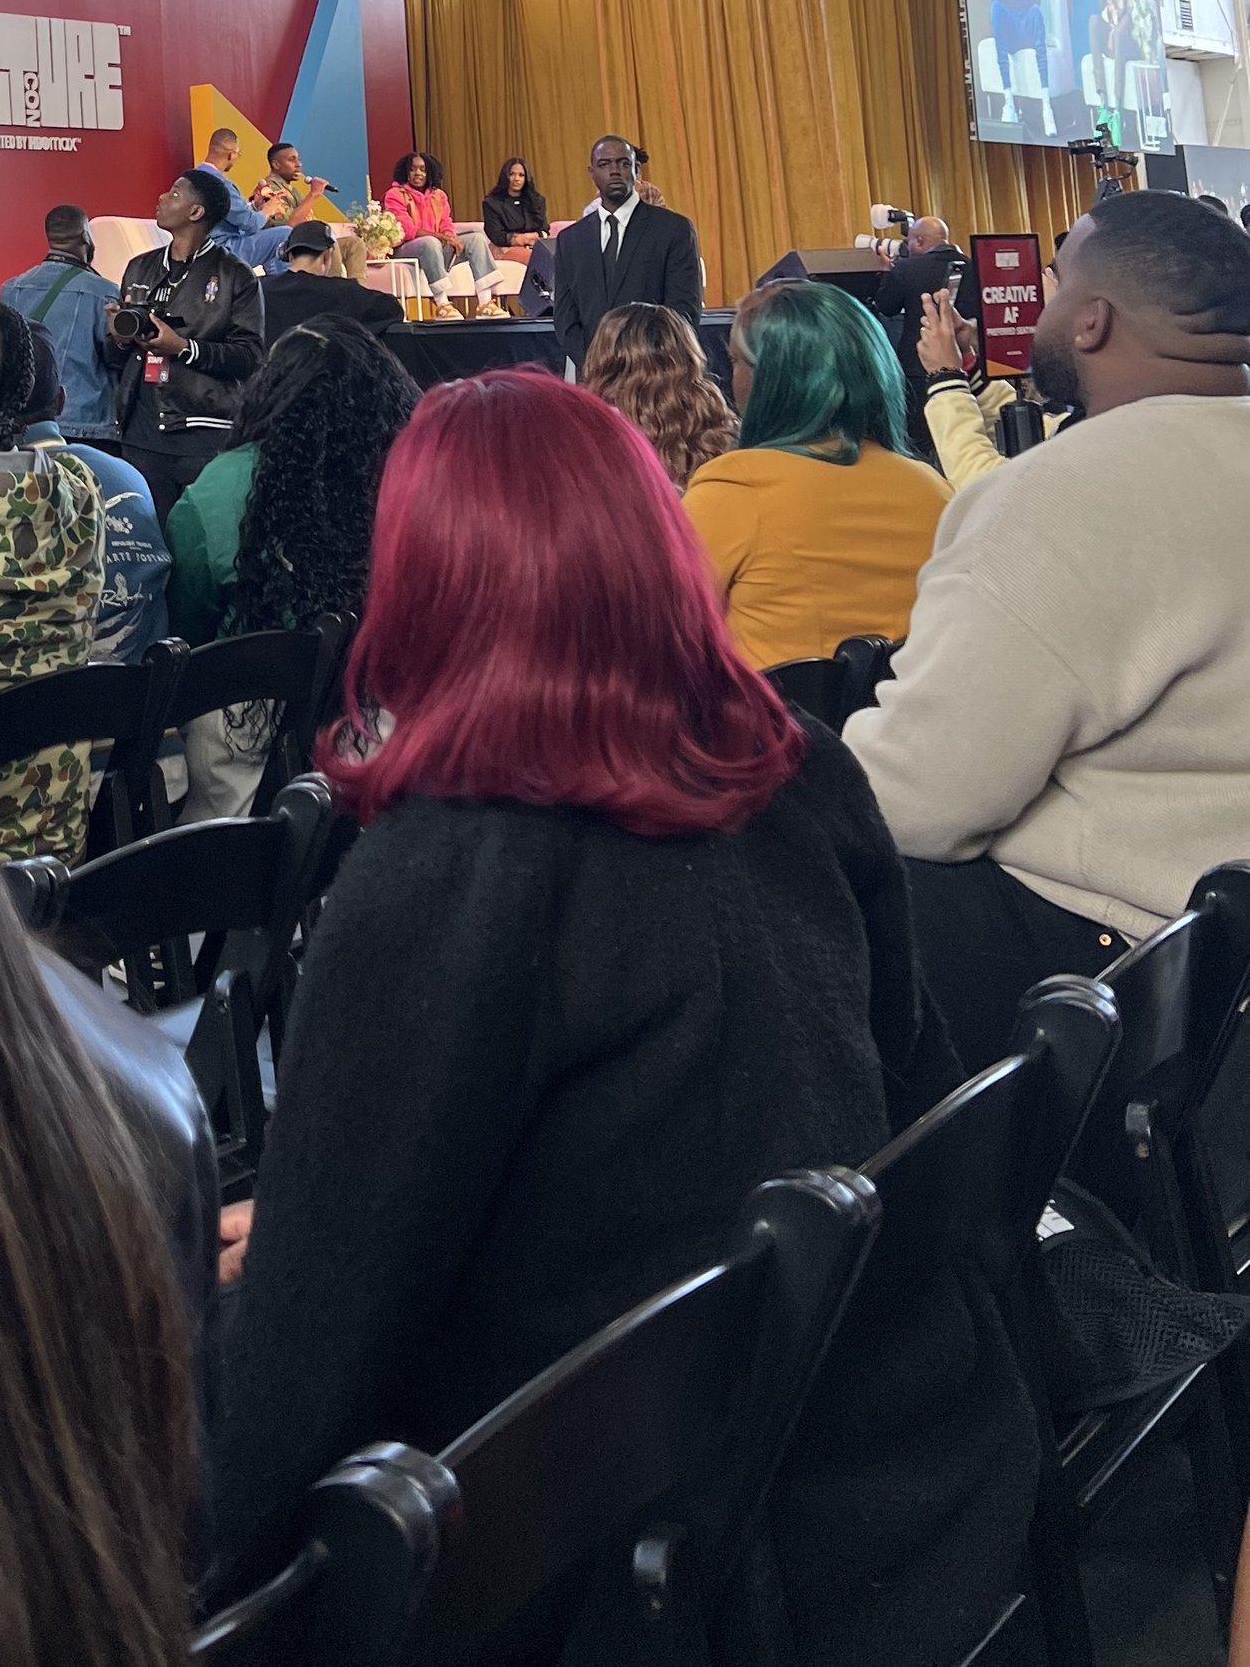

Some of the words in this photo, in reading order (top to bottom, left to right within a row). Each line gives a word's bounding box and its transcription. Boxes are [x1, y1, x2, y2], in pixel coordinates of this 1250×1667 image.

[24, 72, 41, 127] CON
[15, 135, 28, 150] BY
[982, 285, 1037, 304] CREATIVE
[1004, 306, 1019, 324] AF
[105, 552, 132, 565] ARTE
